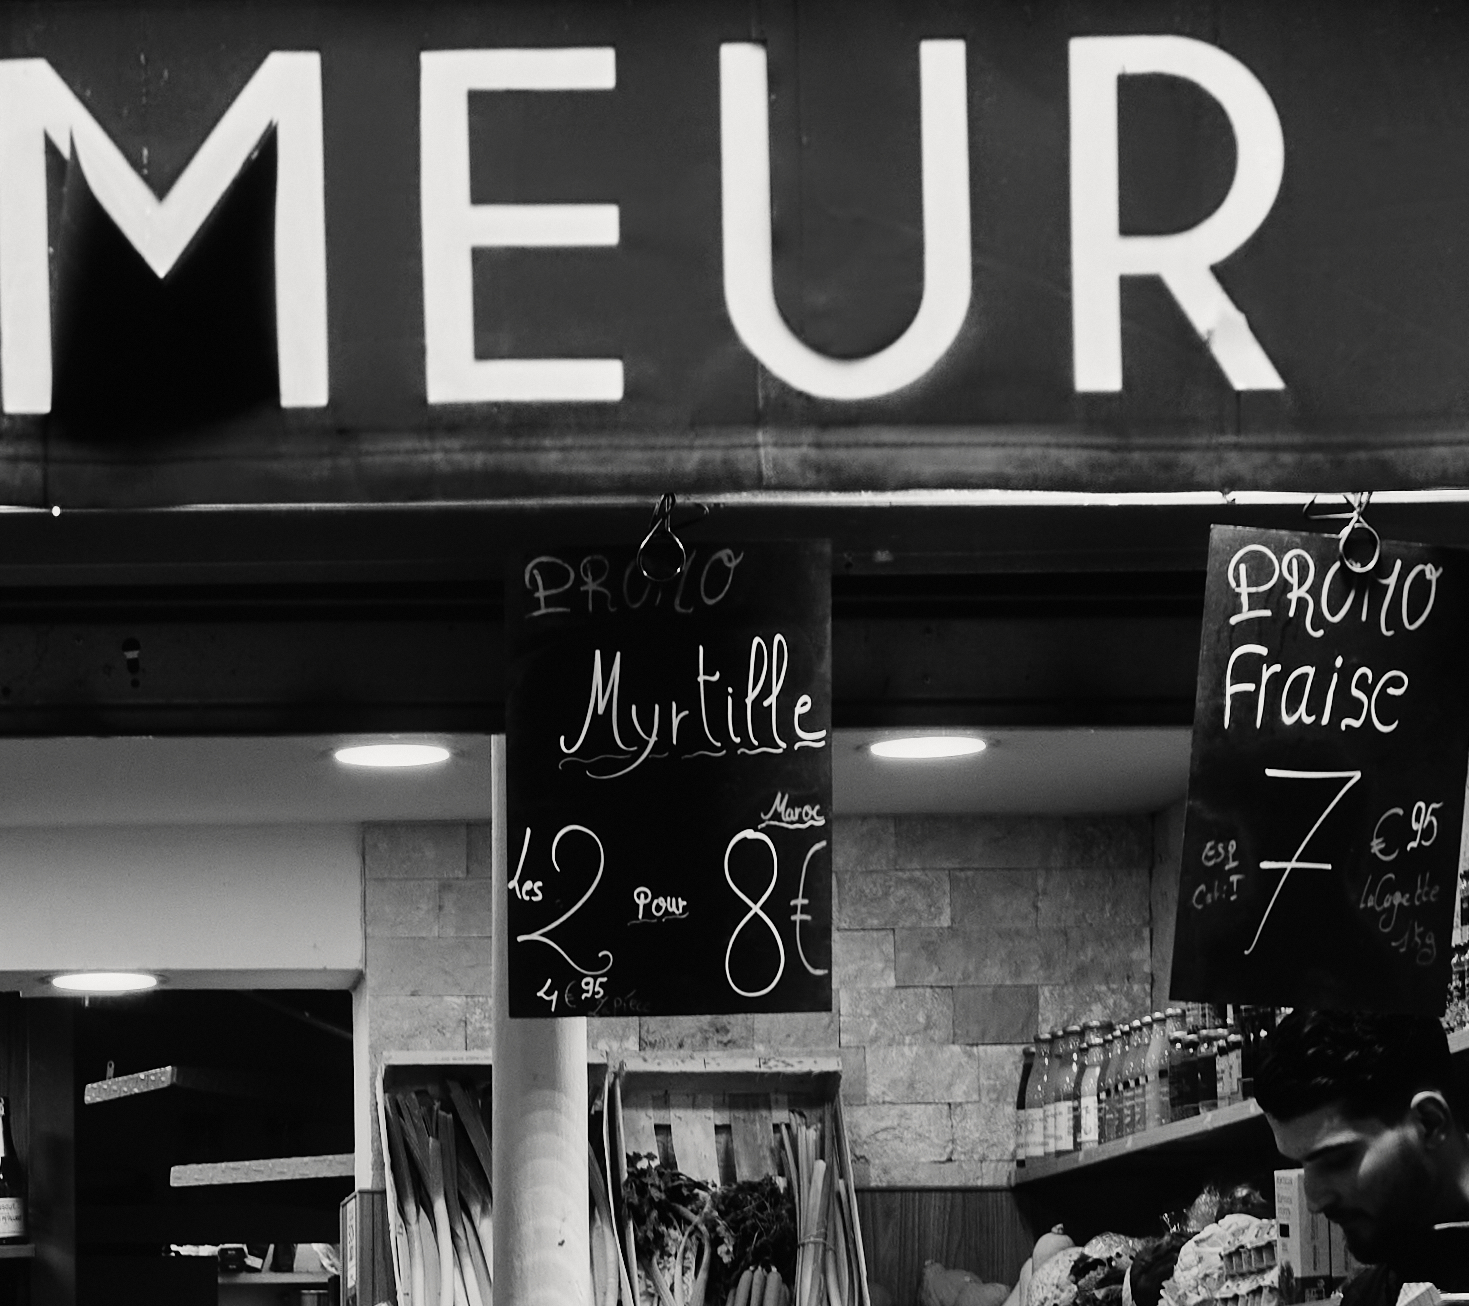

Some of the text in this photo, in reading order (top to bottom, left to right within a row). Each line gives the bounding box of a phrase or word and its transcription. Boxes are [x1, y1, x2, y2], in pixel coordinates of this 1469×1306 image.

[559, 632, 828, 779] Myrtille
[1222, 643, 1412, 735] Fraise
[760, 790, 826, 823] Maroc
[516, 823, 614, 976] 2
[632, 885, 689, 922] Pour
